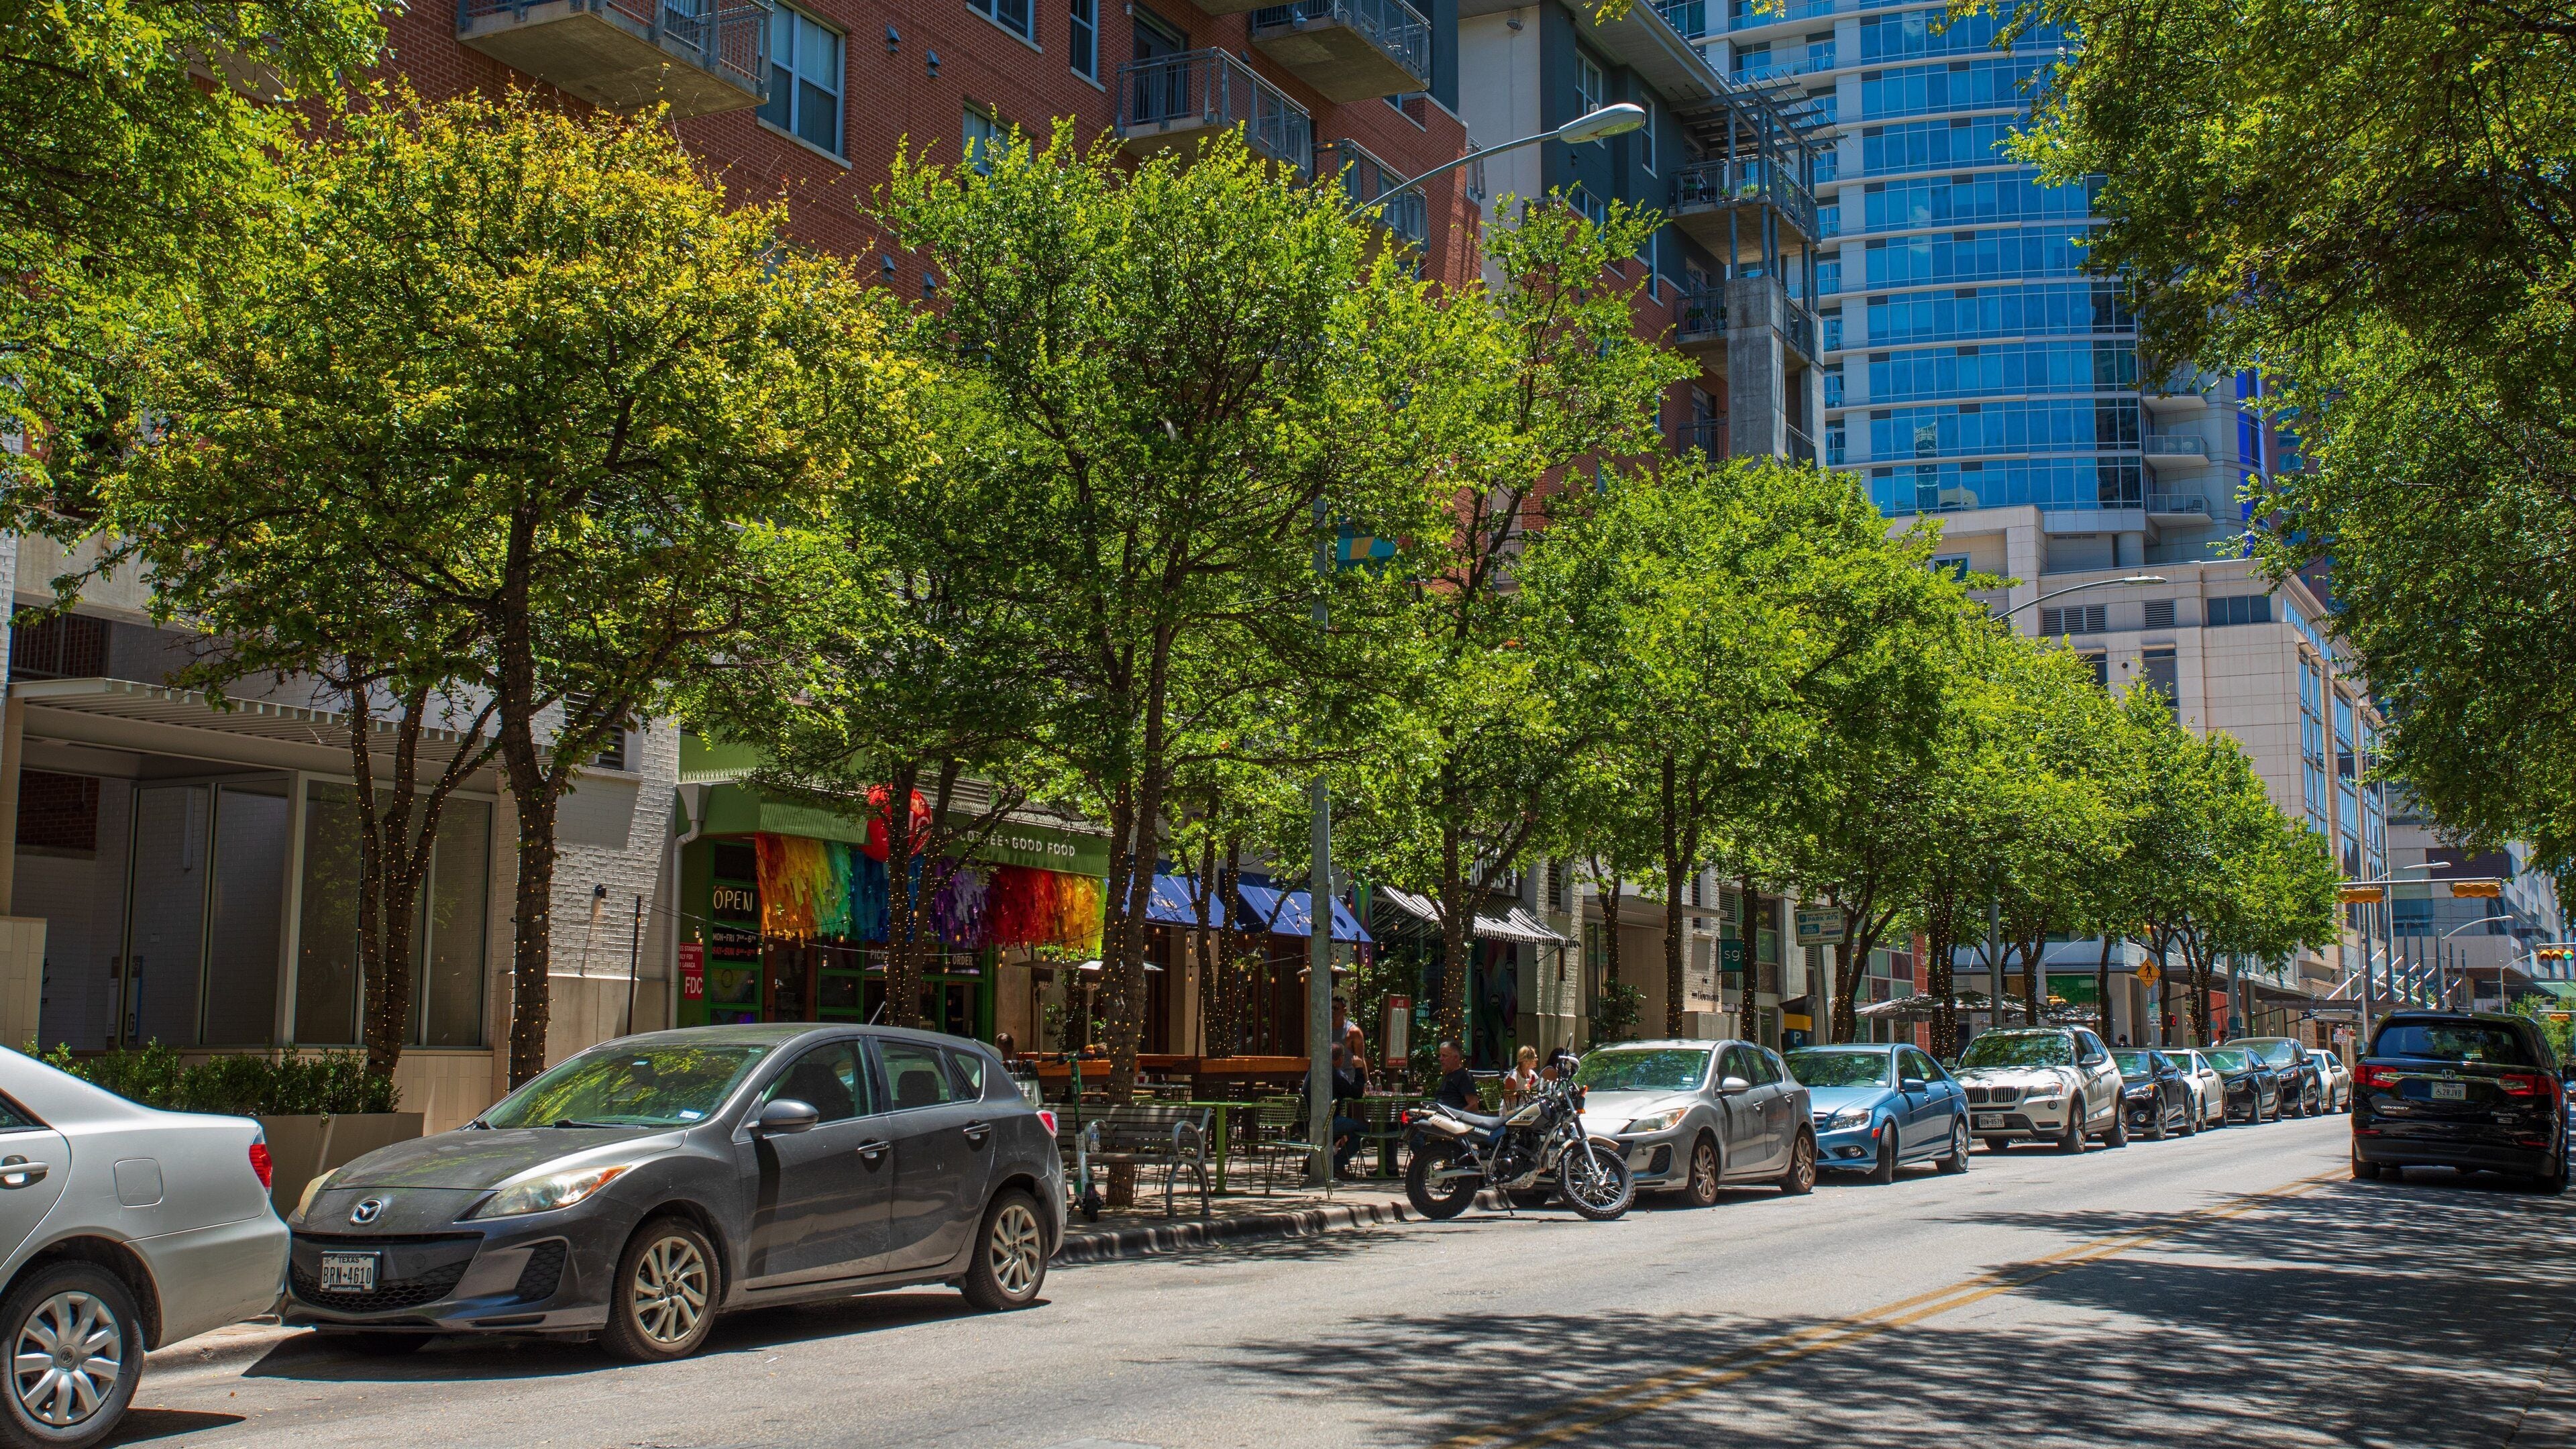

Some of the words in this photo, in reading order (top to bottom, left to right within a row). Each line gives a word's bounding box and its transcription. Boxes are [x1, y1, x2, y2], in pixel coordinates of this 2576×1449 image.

[959, 830, 1003, 846] COEE
[1012, 837, 1042, 852] GOOD
[1047, 842, 1075, 857] FOOD
[713, 890, 753, 912] OPEN
[953, 955, 973, 966] ORDER
[1724, 950, 1740, 961] sg
[685, 977, 703, 994] FDC
[1794, 1032, 1802, 1044] P
[1474, 1126, 1491, 1136] YAMAHA
